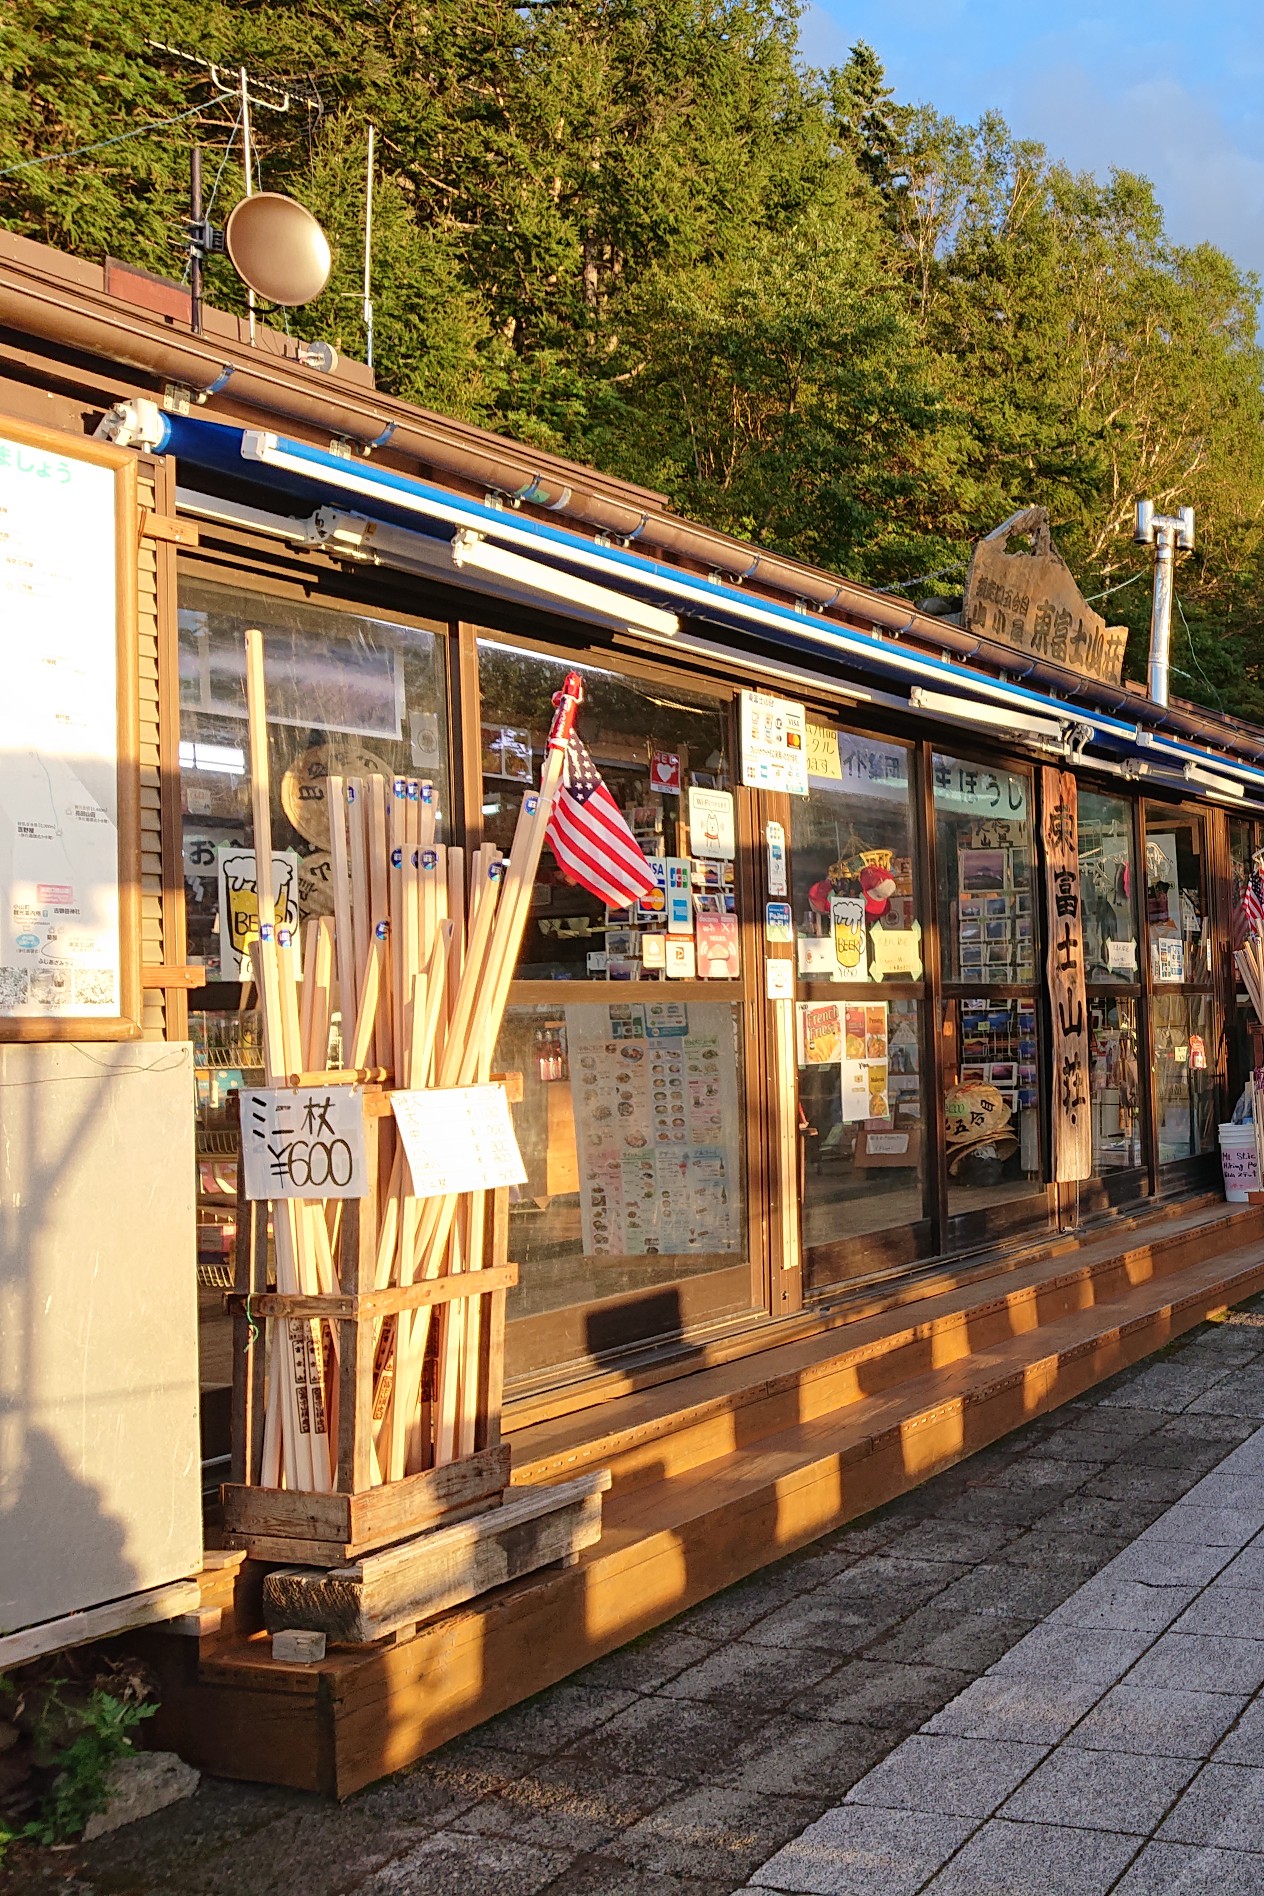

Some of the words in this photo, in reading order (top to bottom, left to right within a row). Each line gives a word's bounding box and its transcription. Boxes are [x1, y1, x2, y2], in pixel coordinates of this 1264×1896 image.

[1030, 599, 1122, 686] 東富士山荘
[838, 938, 860, 953] BEER
[1048, 797, 1087, 1116] 東富士山荘
[807, 1005, 839, 1028] French
[809, 1024, 834, 1041] Fries
[250, 1096, 336, 1138] ミニ杖
[267, 1138, 353, 1189] ¥600
